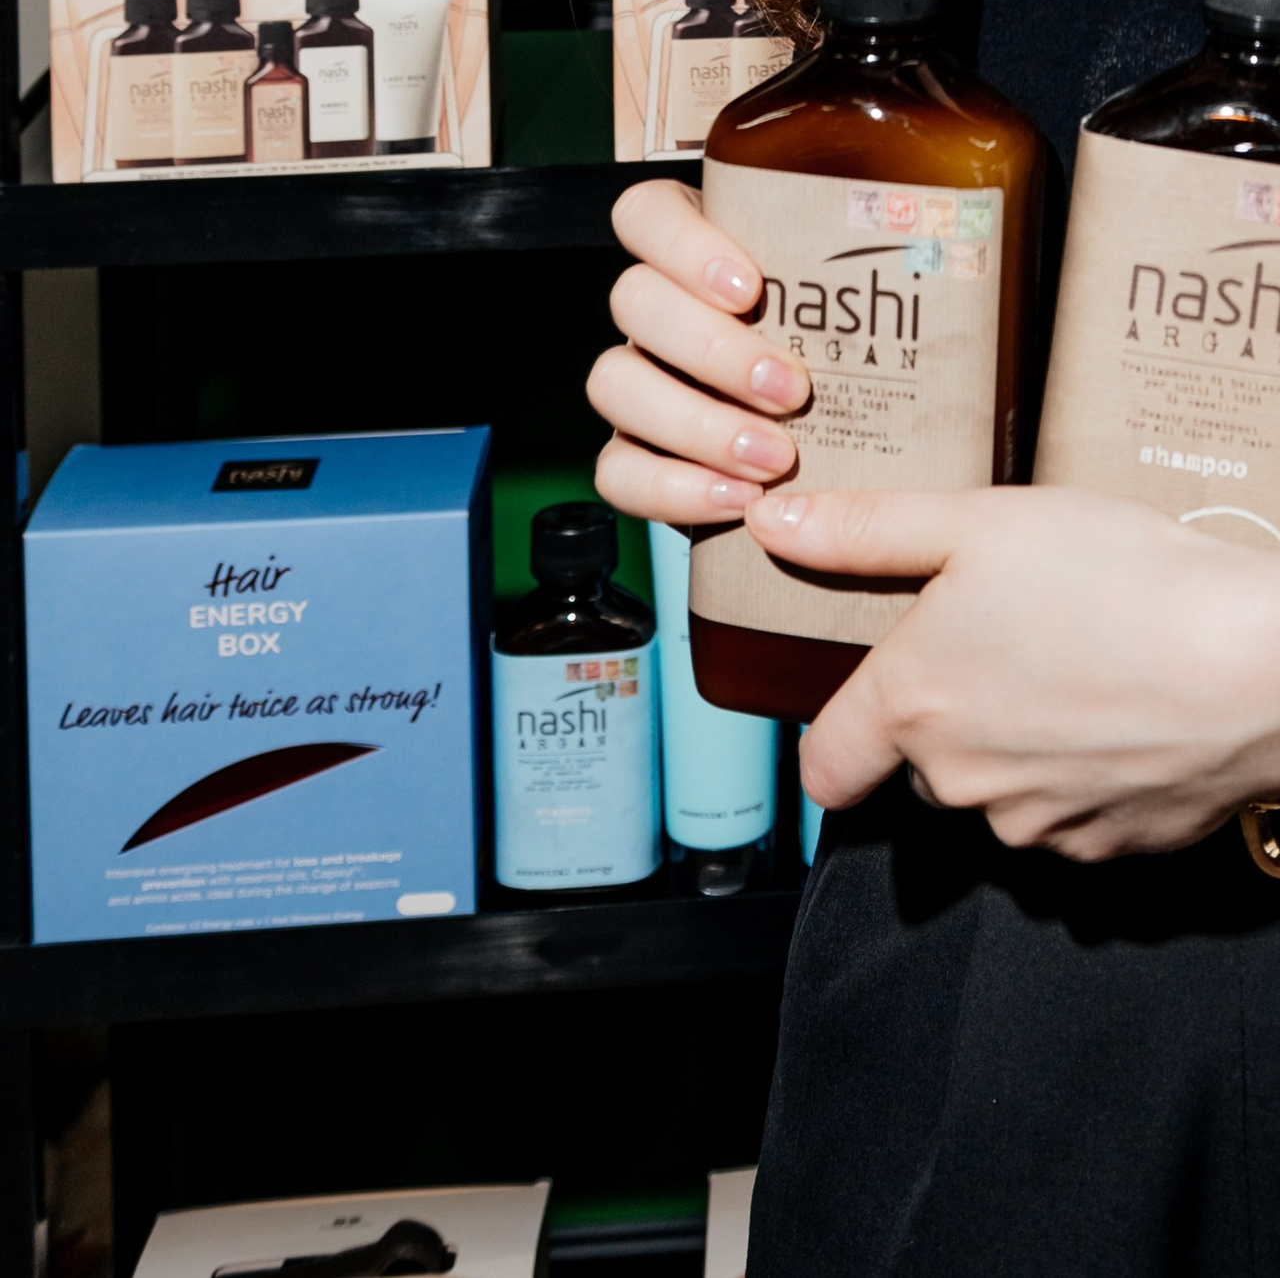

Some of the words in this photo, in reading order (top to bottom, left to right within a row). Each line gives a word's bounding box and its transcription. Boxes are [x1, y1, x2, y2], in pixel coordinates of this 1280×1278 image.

[690, 62, 731, 80] nash
[129, 79, 171, 98] nash
[189, 77, 238, 95] nashi
[257, 103, 297, 119] nashi
[763, 269, 921, 341] nashi
[789, 335, 917, 370] RGAN
[1145, 379, 1167, 392] per
[1175, 381, 1210, 397] tutti
[1233, 392, 1262, 408] tipi
[863, 399, 889, 414] tipi
[1188, 399, 1239, 414] capello
[782, 420, 817, 435] eauty
[825, 425, 890, 441] treatment
[1140, 408, 1184, 427] Beauty
[1193, 416, 1259, 437] treatment
[818, 438, 846, 449] kind
[852, 441, 866, 451] of
[874, 443, 903, 455] hair
[1154, 424, 1175, 436] all
[1184, 428, 1213, 441] kind
[1220, 433, 1235, 445] of
[1243, 438, 1272, 452] hair
[1138, 443, 1249, 480] shampoo
[203, 554, 292, 599] Hair
[189, 599, 309, 630] ENERGY
[217, 630, 282, 658] BOX
[58, 700, 154, 731] Leaves
[160, 690, 224, 724] hair
[228, 689, 300, 722] twice
[306, 694, 339, 716] as
[344, 681, 443, 724] strong!
[517, 698, 606, 736] nashi
[321, 854, 344, 866] and
[141, 877, 206, 893] prevention
[294, 883, 337, 897] change
